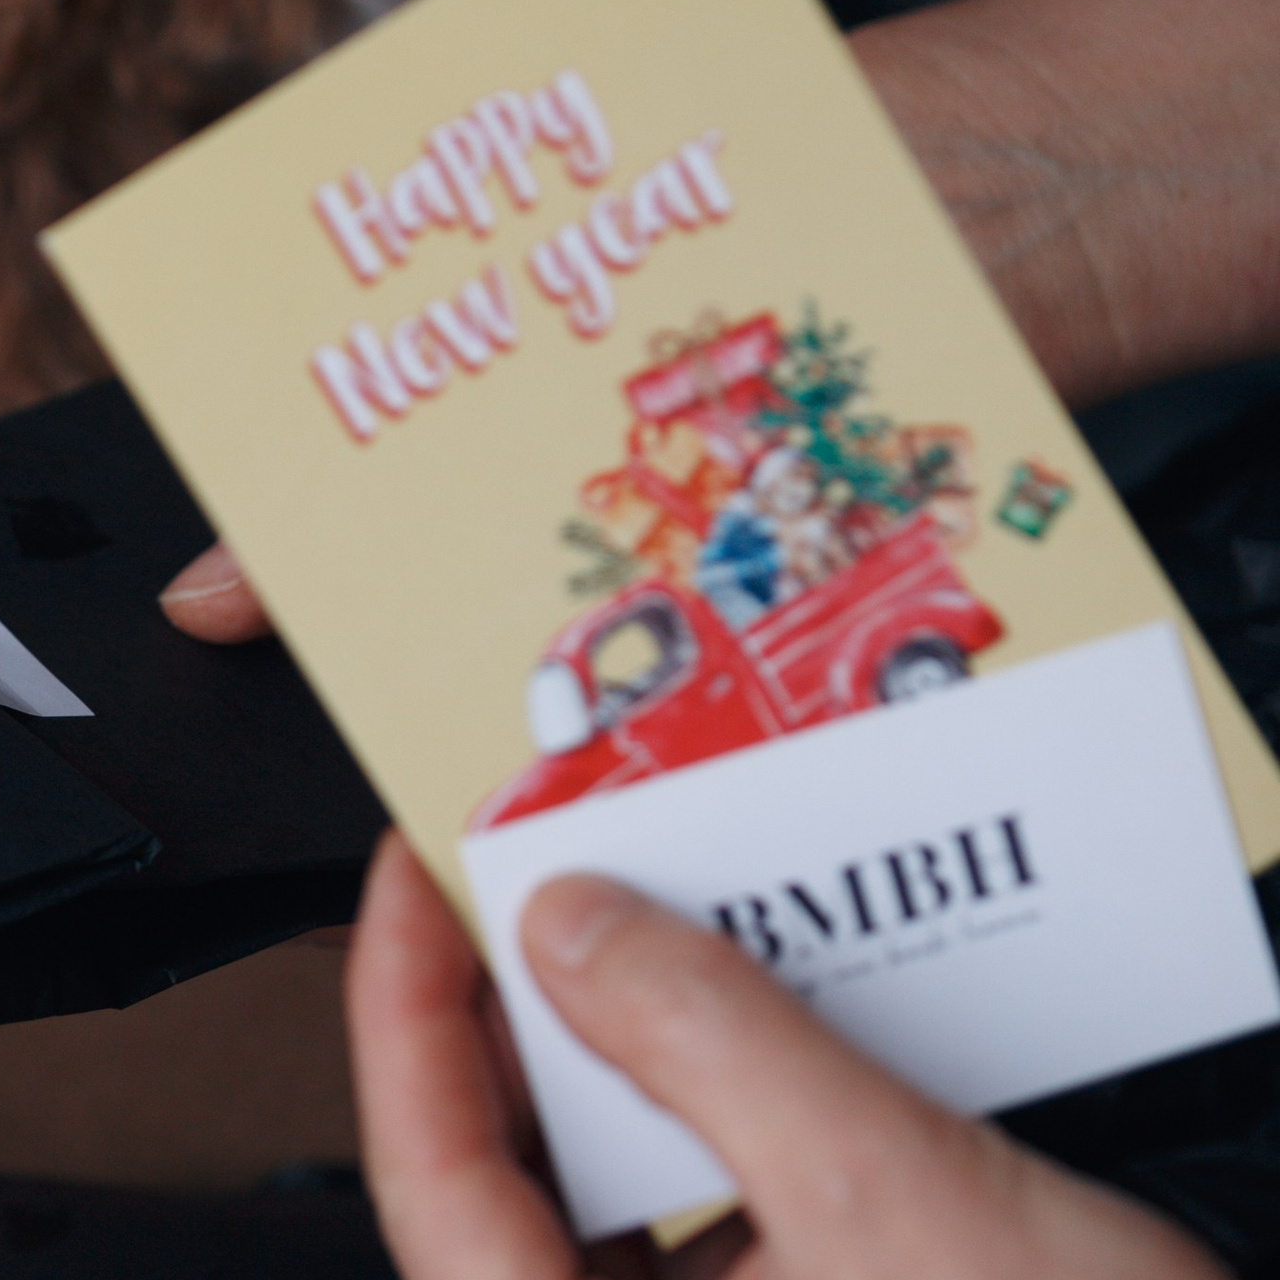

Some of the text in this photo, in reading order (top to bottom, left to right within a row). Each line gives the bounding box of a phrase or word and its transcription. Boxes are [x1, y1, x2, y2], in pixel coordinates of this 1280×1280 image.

[312, 68, 613, 286] Happy
[312, 130, 734, 447] New year
